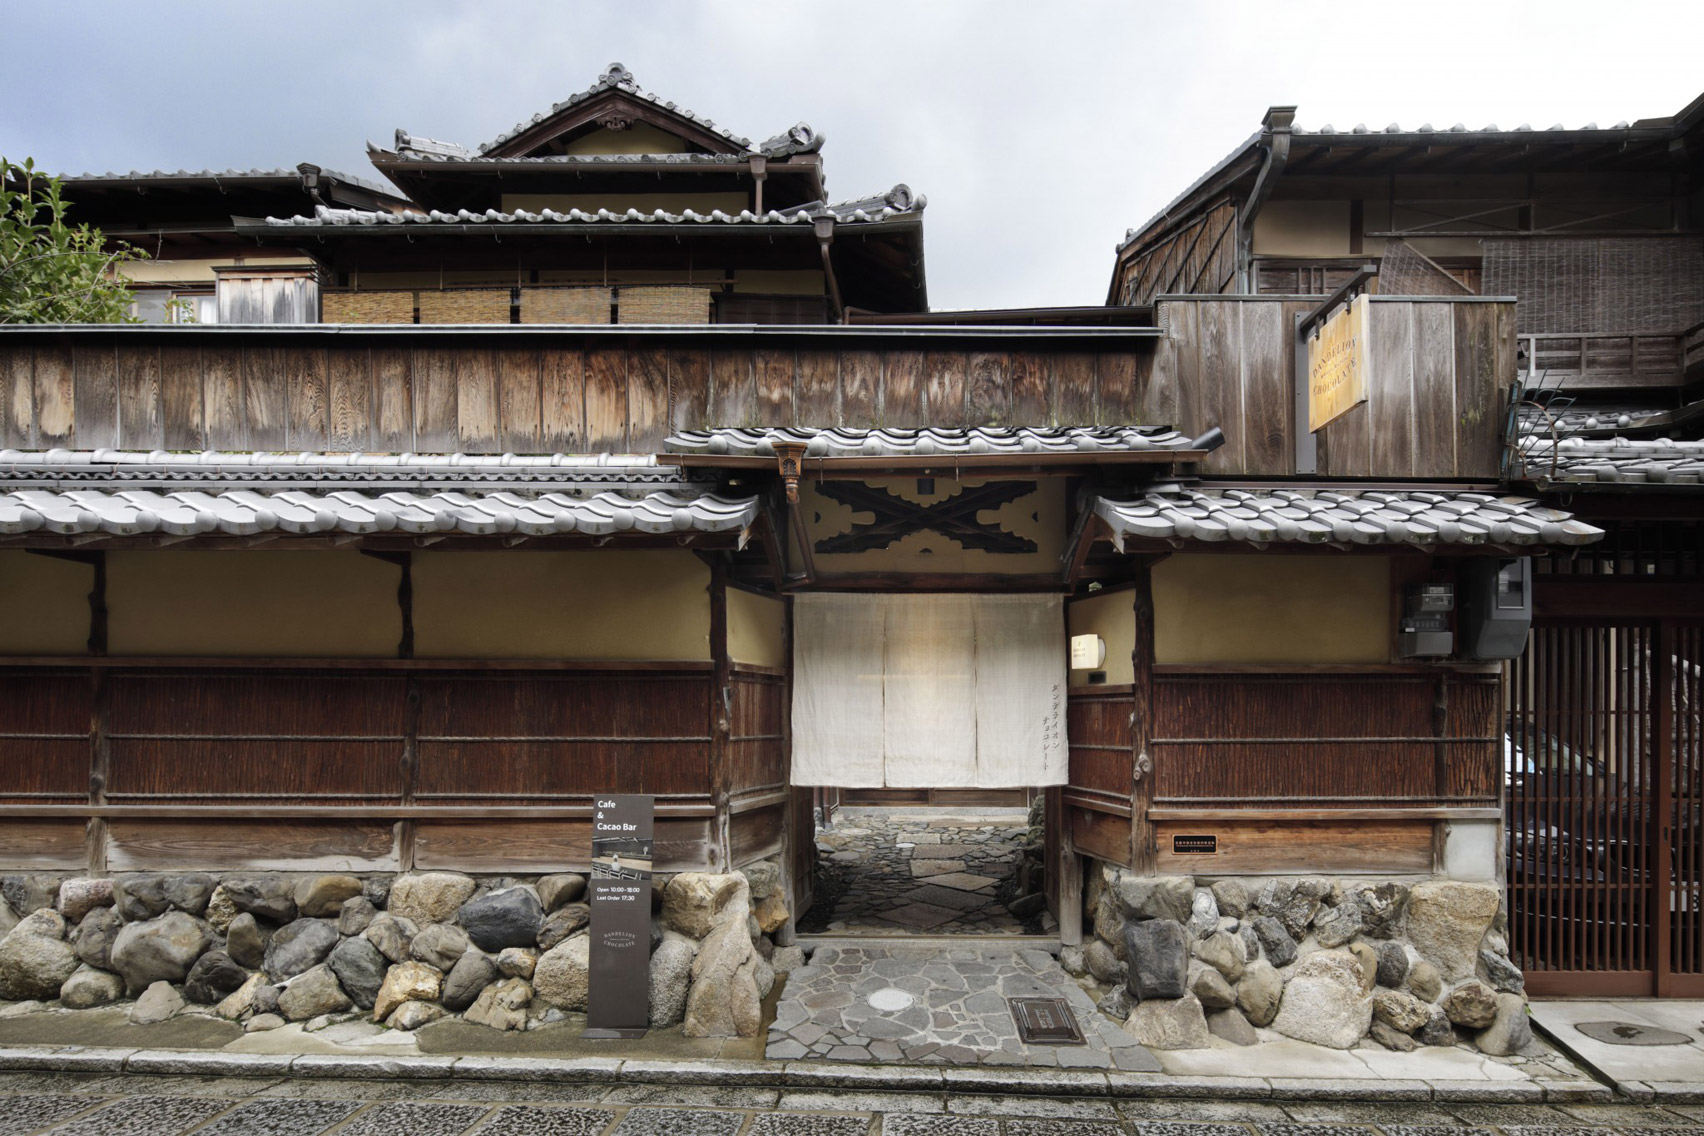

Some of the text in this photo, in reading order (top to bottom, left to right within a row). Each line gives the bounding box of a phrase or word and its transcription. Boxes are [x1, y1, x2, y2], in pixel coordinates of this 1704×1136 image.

[1312, 337, 1356, 379] DANDELION
[1313, 357, 1356, 396] CHOCOLATE
[598, 800, 616, 808] Cafe
